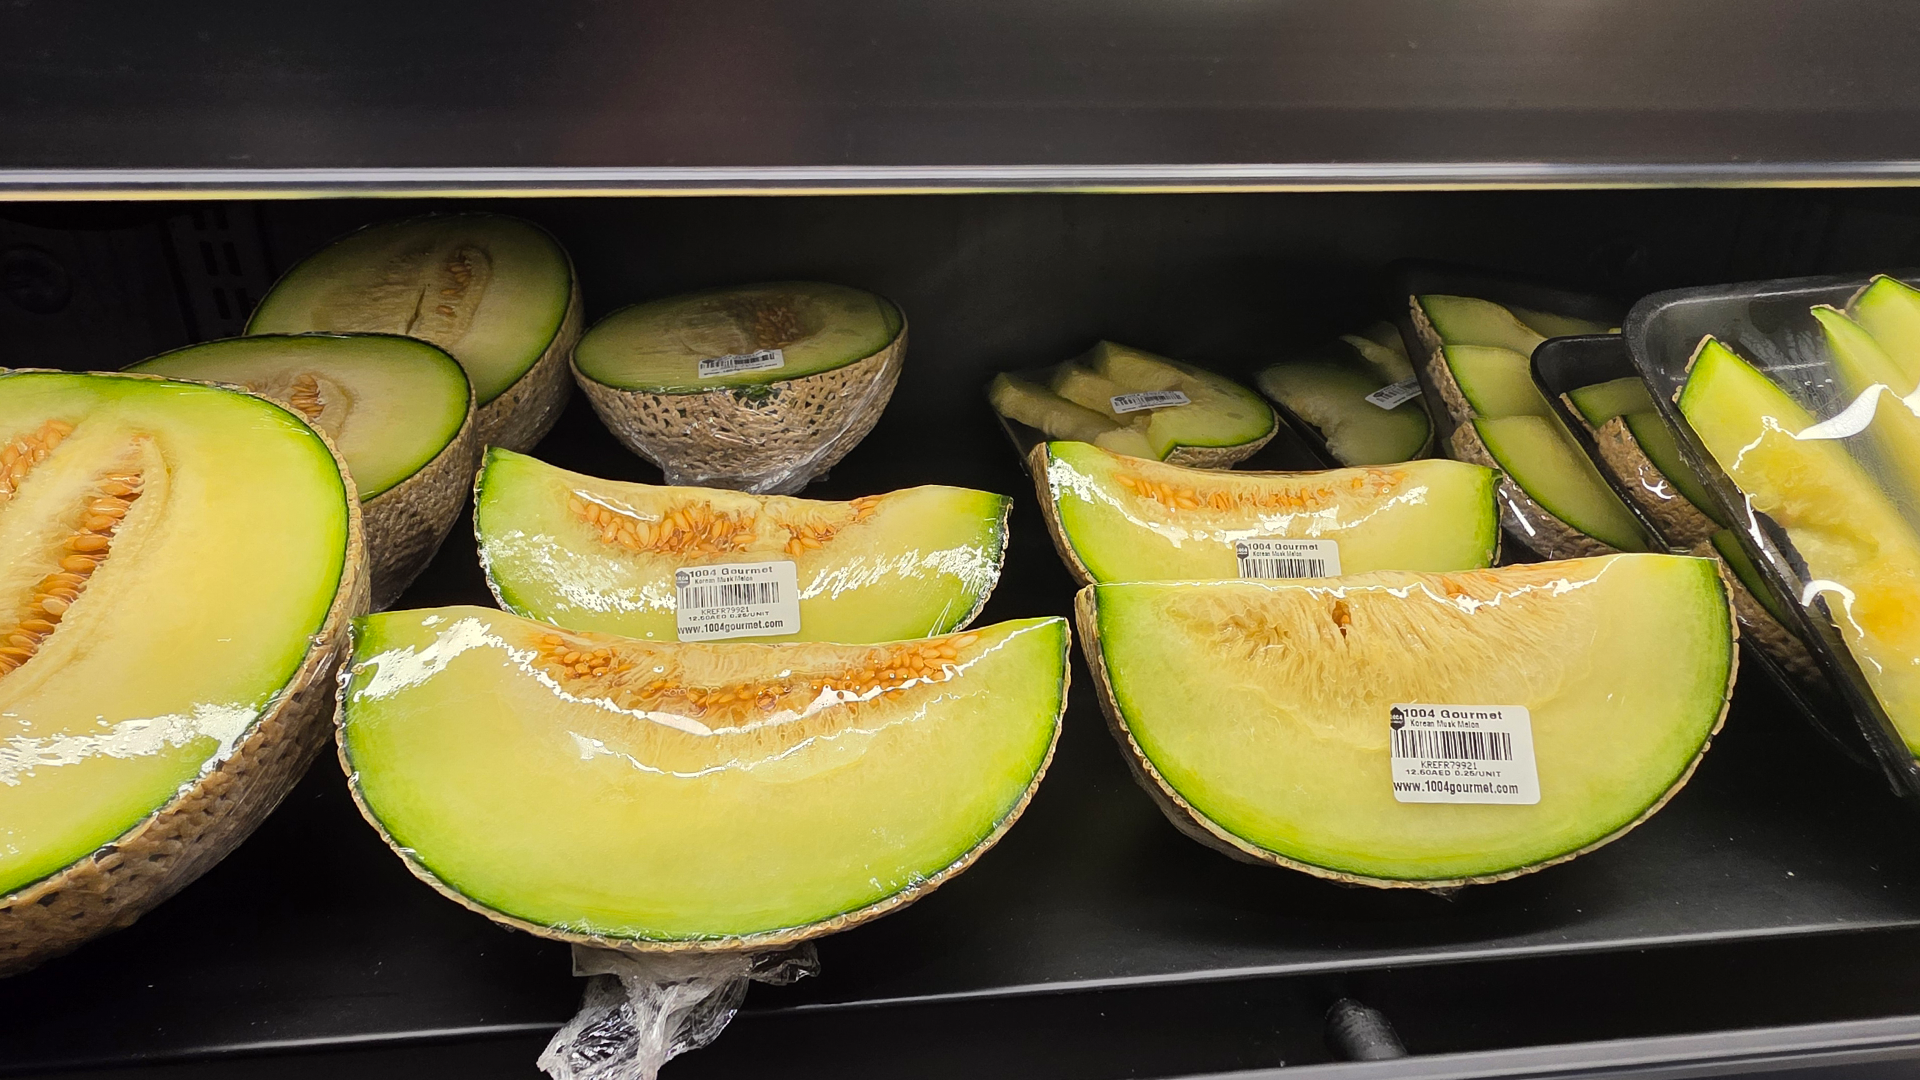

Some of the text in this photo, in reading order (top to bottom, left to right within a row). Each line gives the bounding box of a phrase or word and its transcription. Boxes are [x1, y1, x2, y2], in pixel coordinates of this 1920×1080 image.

[1275, 543, 1318, 551] Gourmet
[690, 566, 773, 578] 1004 Gourmet
[678, 620, 784, 634] www.1004gourmet.com
[1403, 709, 1503, 720] 1004 Gourmet
[1410, 720, 1435, 728] Korean
[1437, 720, 1456, 728] Musk
[1458, 721, 1480, 729] Melon
[1421, 761, 1477, 770] KREFR79921
[1393, 780, 1519, 795] www.1004gourmet.com
